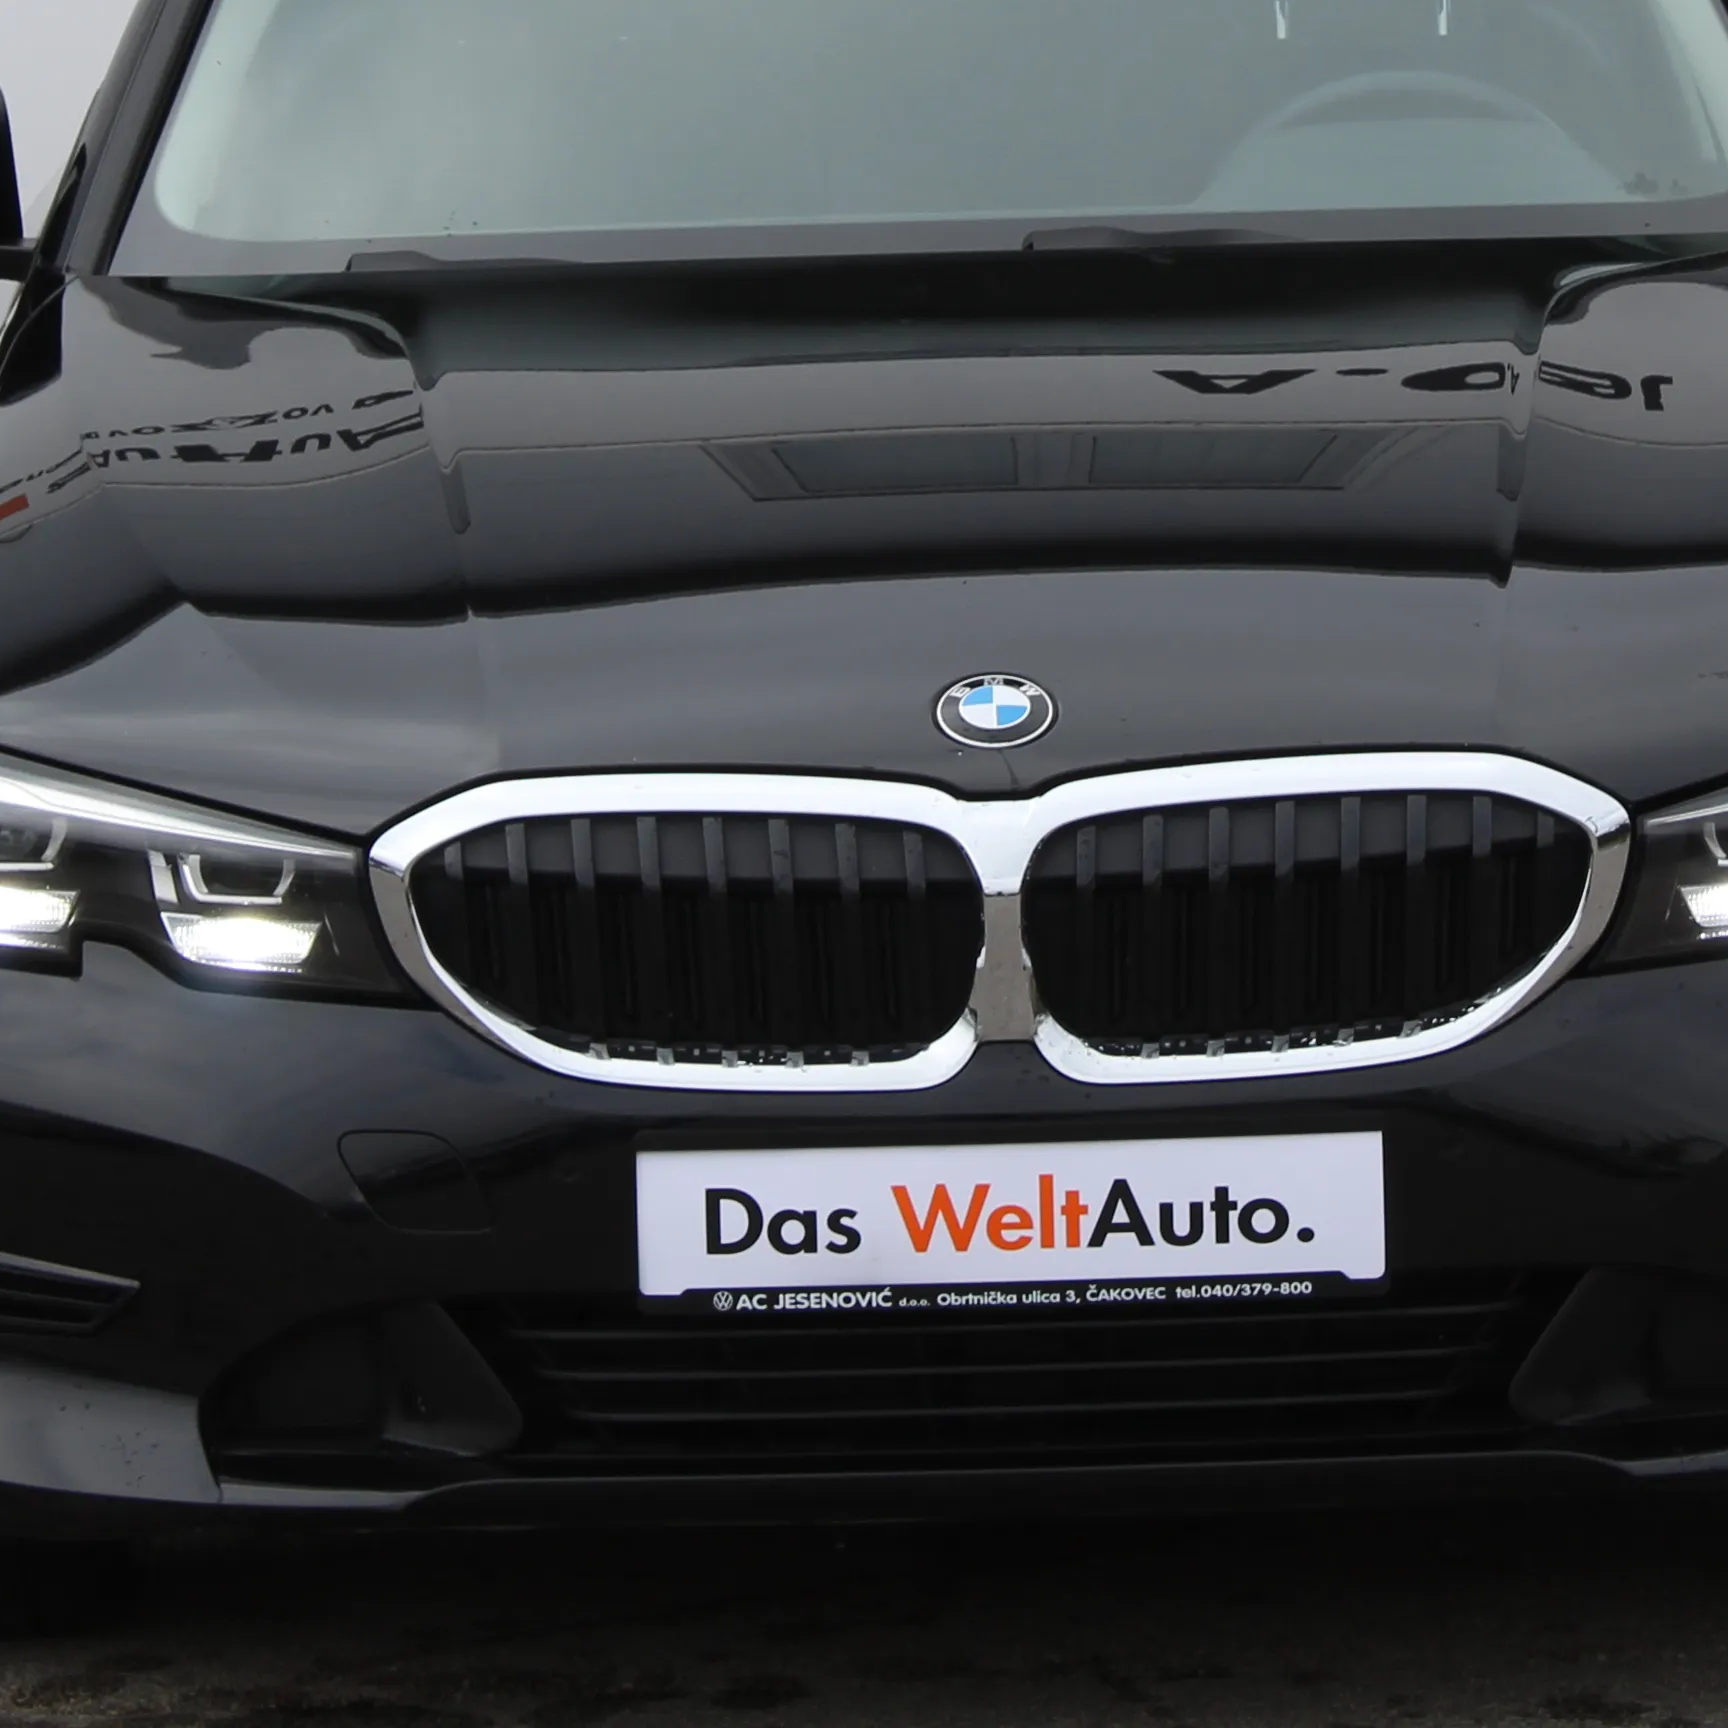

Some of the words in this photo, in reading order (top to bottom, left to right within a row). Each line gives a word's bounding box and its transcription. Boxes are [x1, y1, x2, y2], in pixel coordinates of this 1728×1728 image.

[704, 1188, 861, 1255] Das
[892, 1175, 1314, 1252] WeltAuto.
[736, 1293, 768, 1310] AC
[774, 1287, 892, 1310] JESENOVIĆ
[937, 1290, 1017, 1306] Obrtnička
[1022, 1290, 1060, 1303] ulica
[1066, 1290, 1080, 1303] 3,
[1086, 1285, 1166, 1301] ČAKOVEC
[1176, 1282, 1312, 1298] tel.040/379-800
